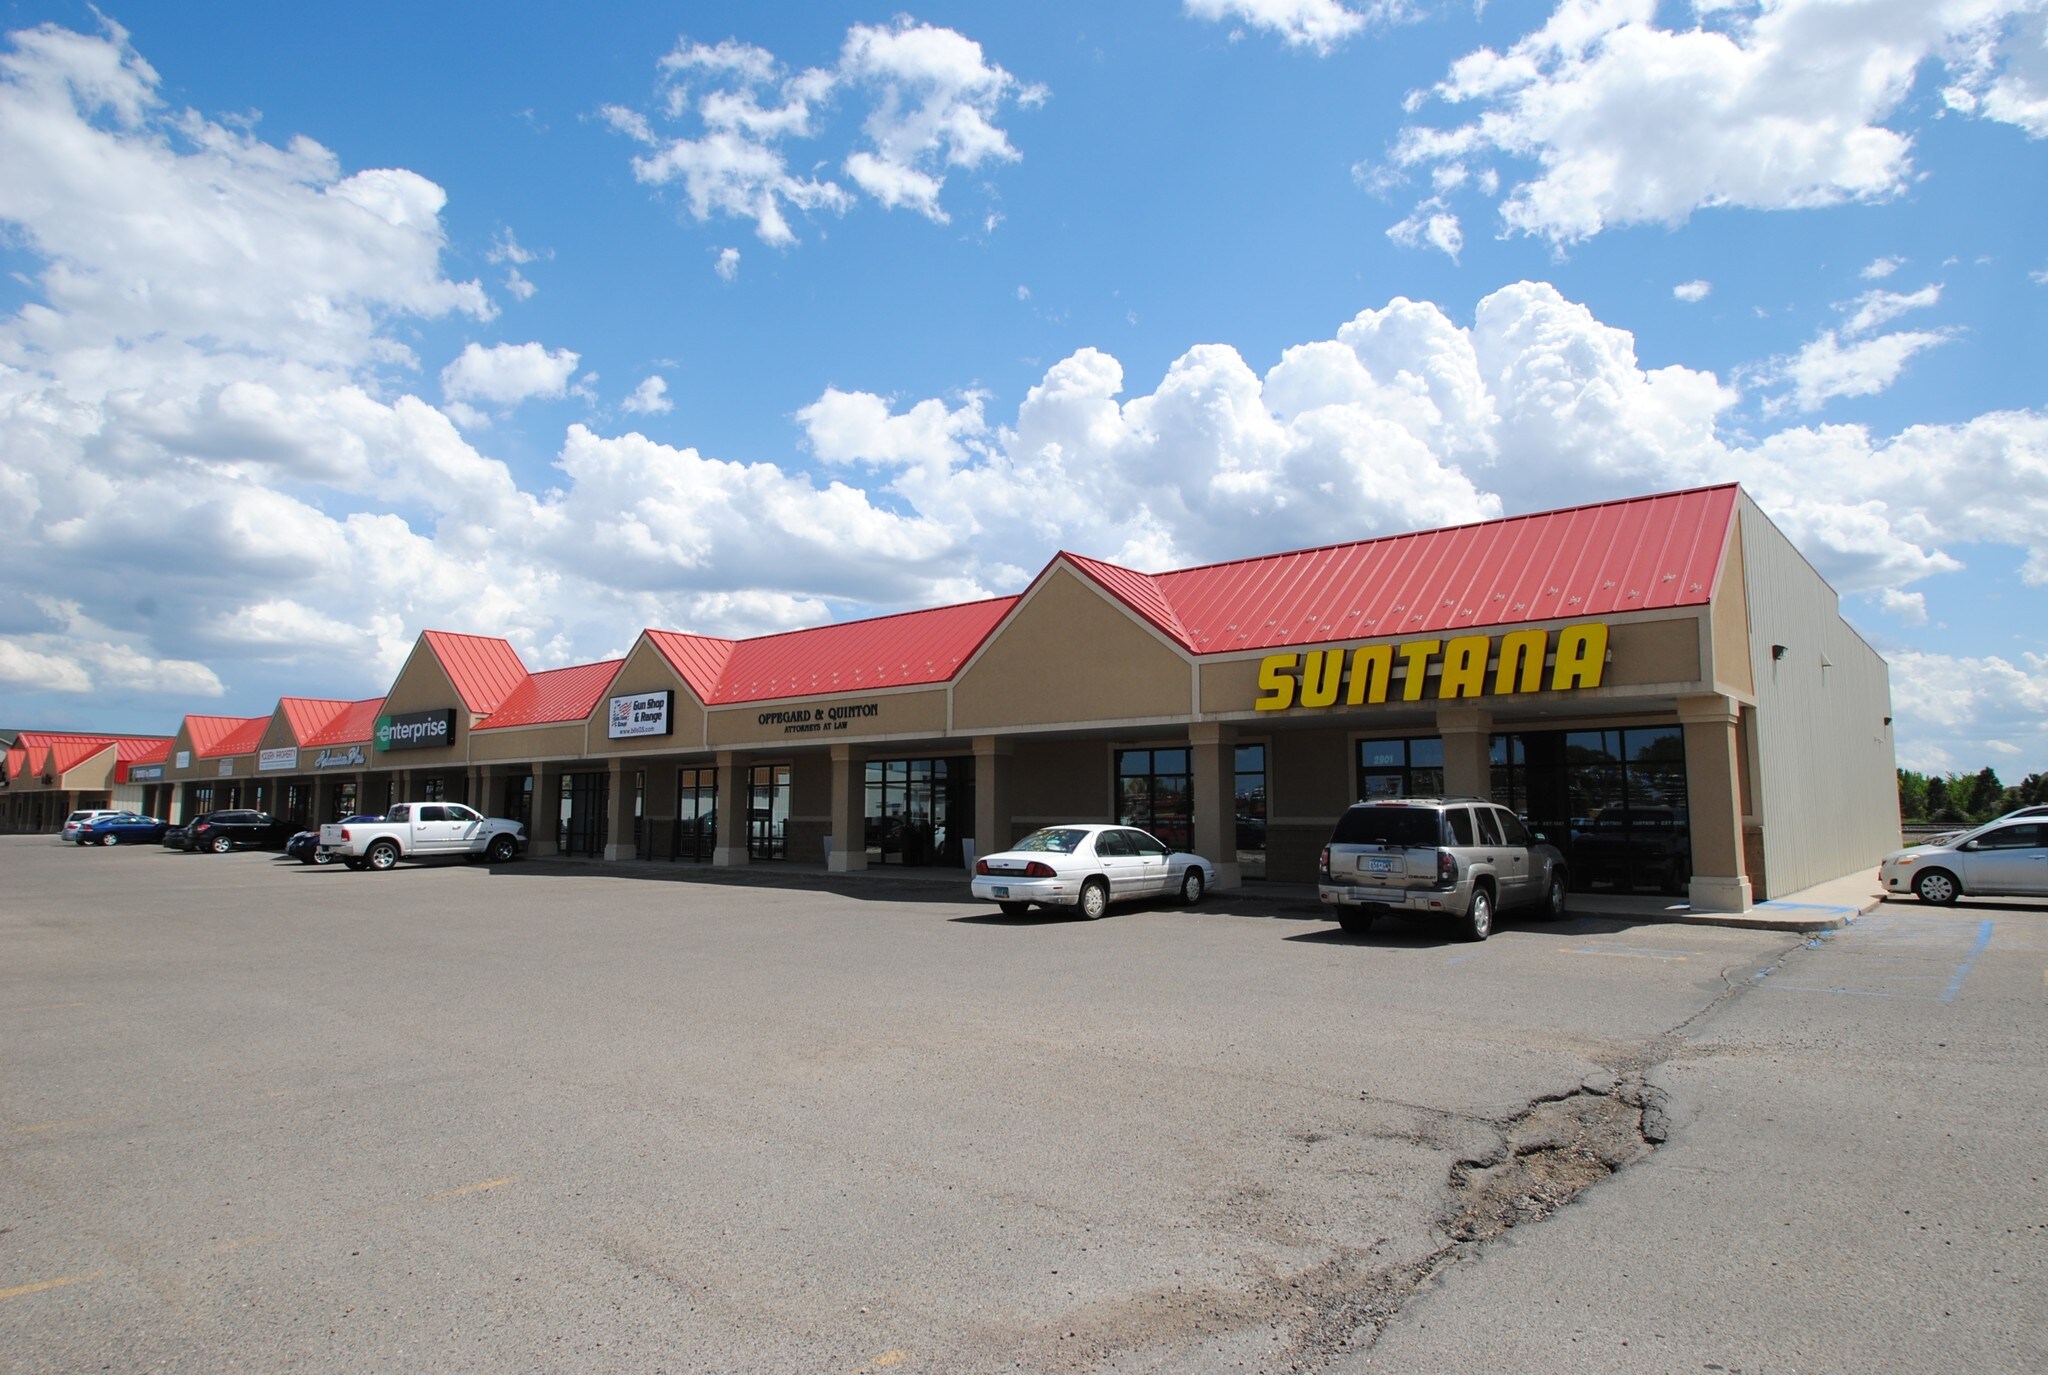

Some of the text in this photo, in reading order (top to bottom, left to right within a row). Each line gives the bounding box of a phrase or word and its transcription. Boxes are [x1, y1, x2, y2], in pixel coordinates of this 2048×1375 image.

[1254, 622, 1609, 711] SUNTANA
[633, 698, 665, 711] Gun Shop
[634, 713, 639, 722] &
[641, 711, 662, 723] Range
[758, 703, 878, 725] OPPEGARD & QUINTON
[378, 717, 447, 742] enterprise
[784, 721, 848, 733] ATTORNEYS AT LAW
[1374, 754, 1394, 764] 2901
